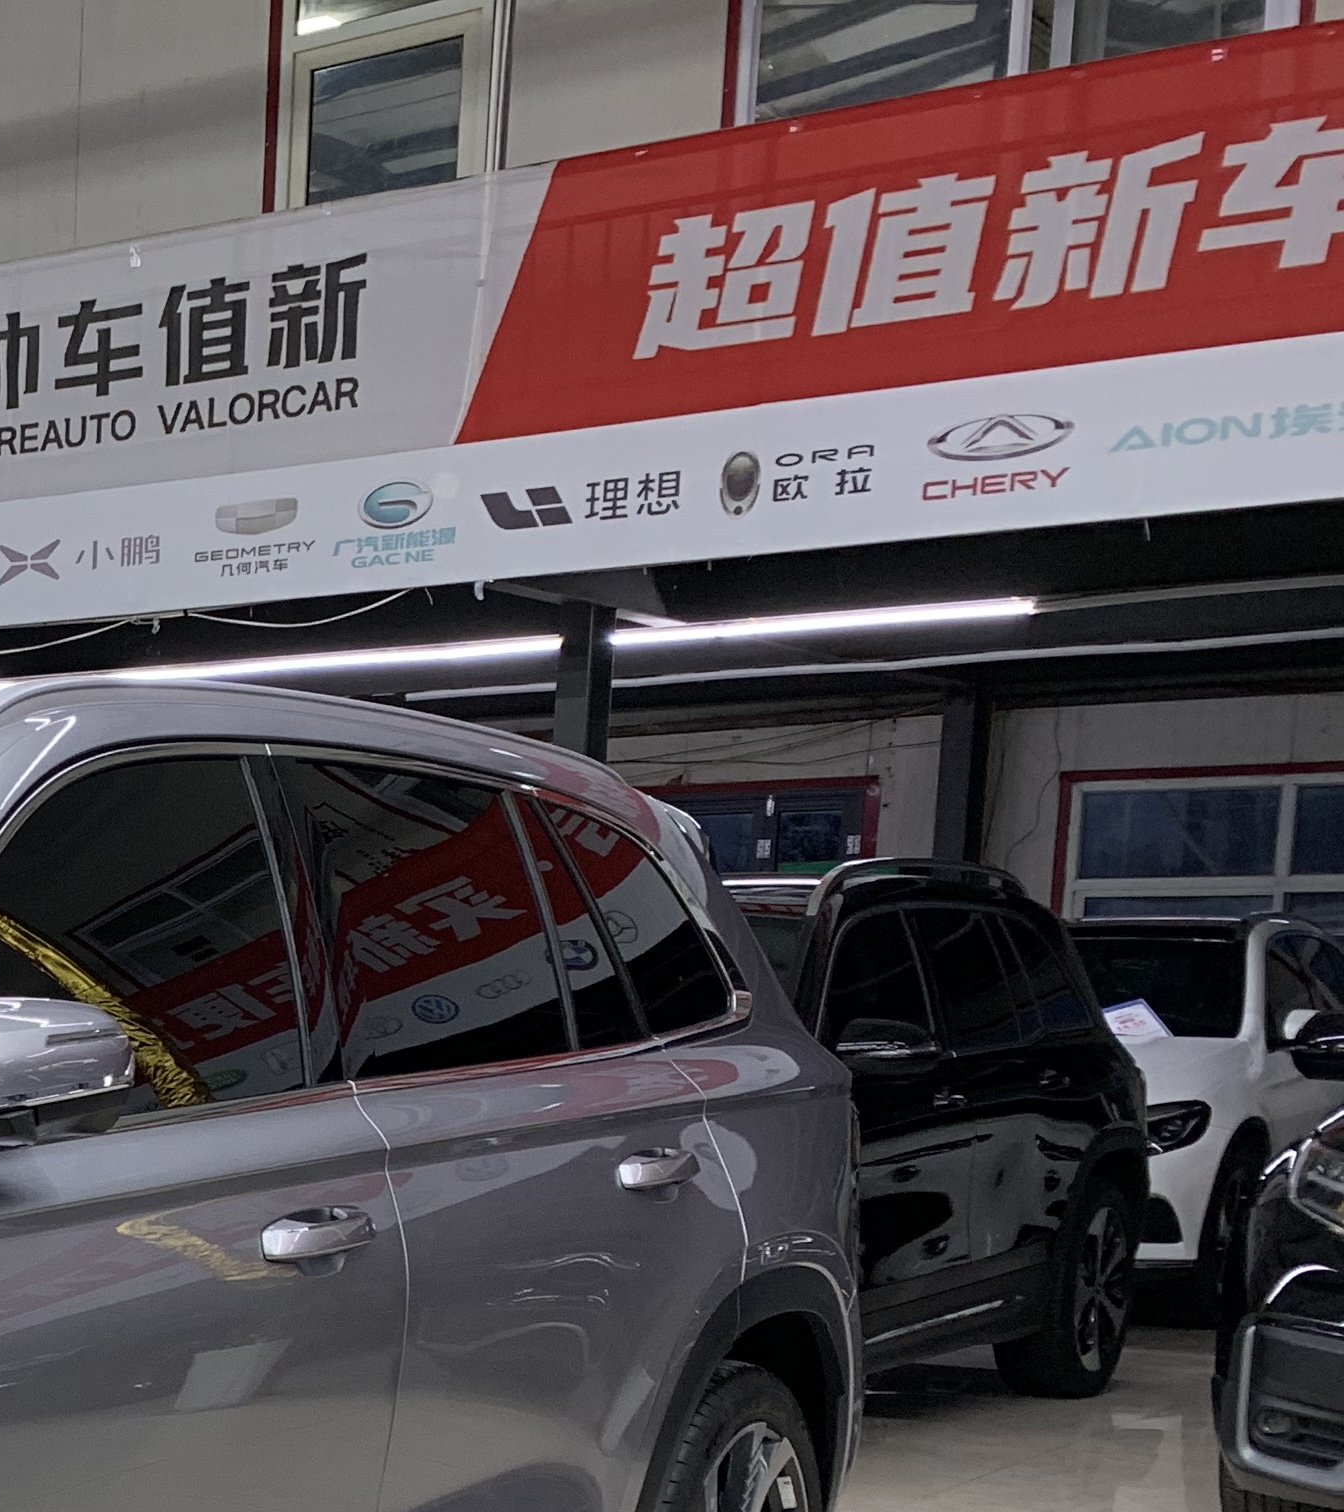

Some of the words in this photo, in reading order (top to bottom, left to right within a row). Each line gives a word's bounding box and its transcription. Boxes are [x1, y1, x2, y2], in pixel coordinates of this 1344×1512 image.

[632, 115, 1344, 361] 超值新车
[158, 376, 360, 435] VALORCAR
[1108, 411, 1263, 453] AION
[1269, 401, 1344, 440] 埃
[775, 444, 876, 467] ORA
[584, 470, 682, 521] 理想
[773, 467, 873, 502] 欧拉
[922, 466, 1071, 502] CHERY
[75, 533, 162, 571] 小鹏
[194, 540, 316, 563] GEOMETRY
[332, 527, 457, 557] 广汽新能源
[220, 558, 289, 578] 几何汽车
